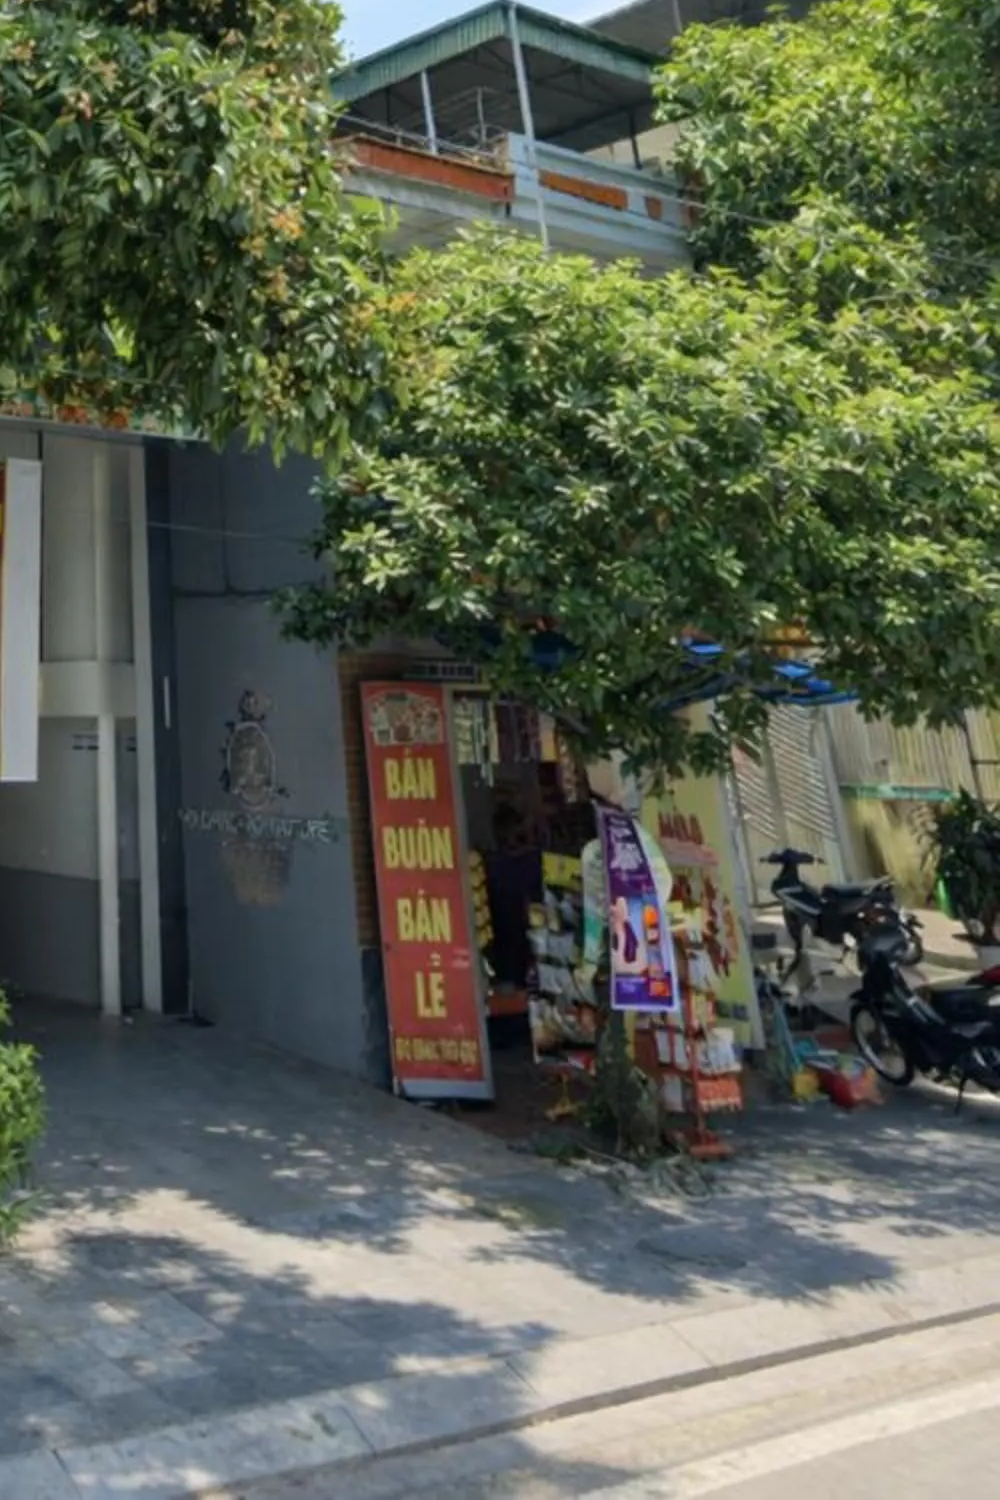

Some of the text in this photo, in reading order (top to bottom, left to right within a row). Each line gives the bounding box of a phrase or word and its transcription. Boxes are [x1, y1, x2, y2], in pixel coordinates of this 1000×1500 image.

[384, 747, 436, 800] BÁN
[382, 817, 454, 871] BUÔN
[397, 888, 452, 944] BÁN
